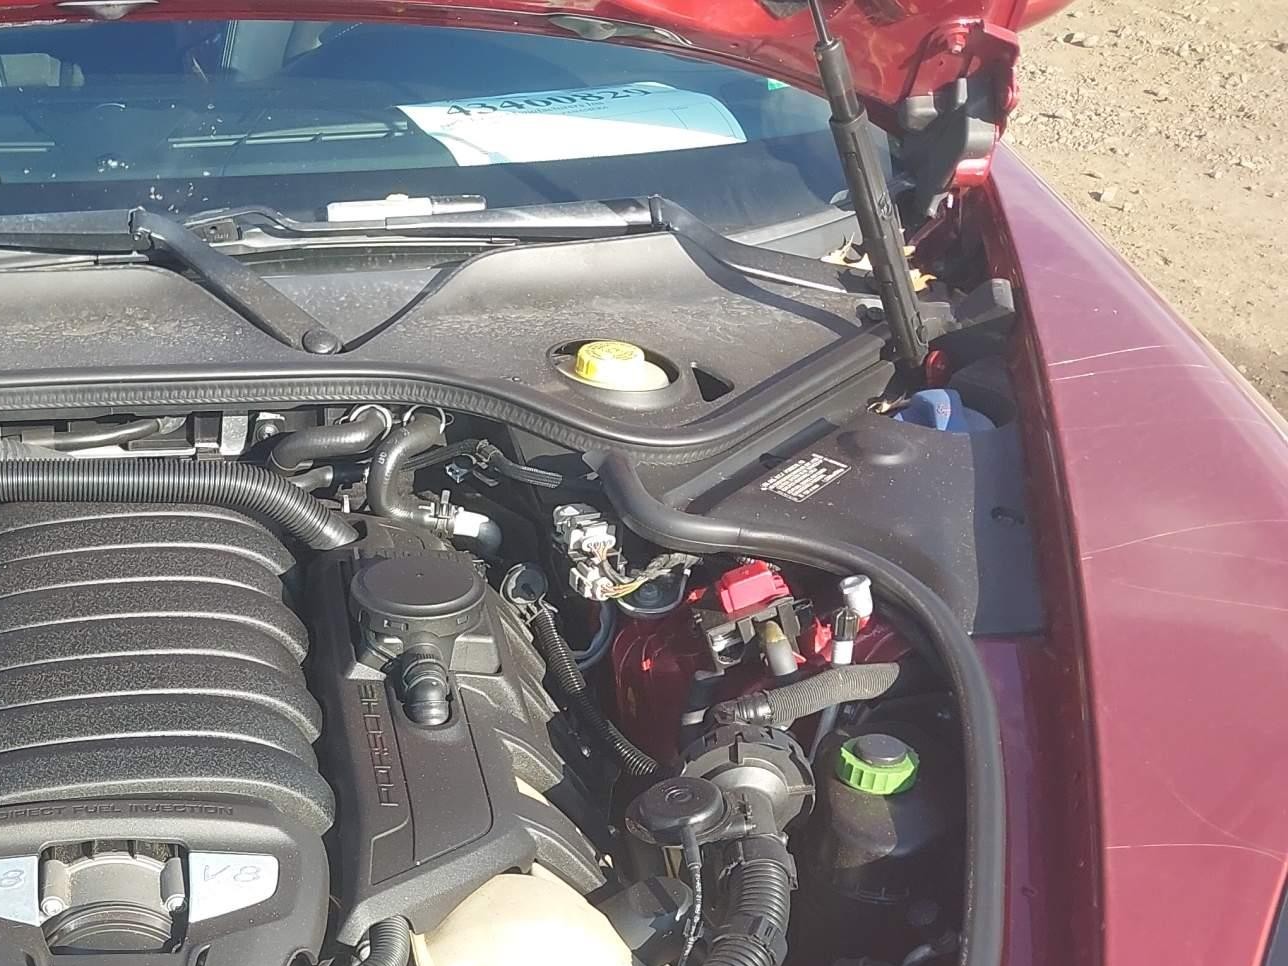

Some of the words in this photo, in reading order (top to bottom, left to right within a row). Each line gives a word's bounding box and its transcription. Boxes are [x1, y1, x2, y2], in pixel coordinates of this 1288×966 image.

[357, 684, 399, 807] PORSCHE
[72, 803, 122, 814] FUEL
[128, 802, 233, 816] INJECTION
[203, 864, 261, 883] V8
